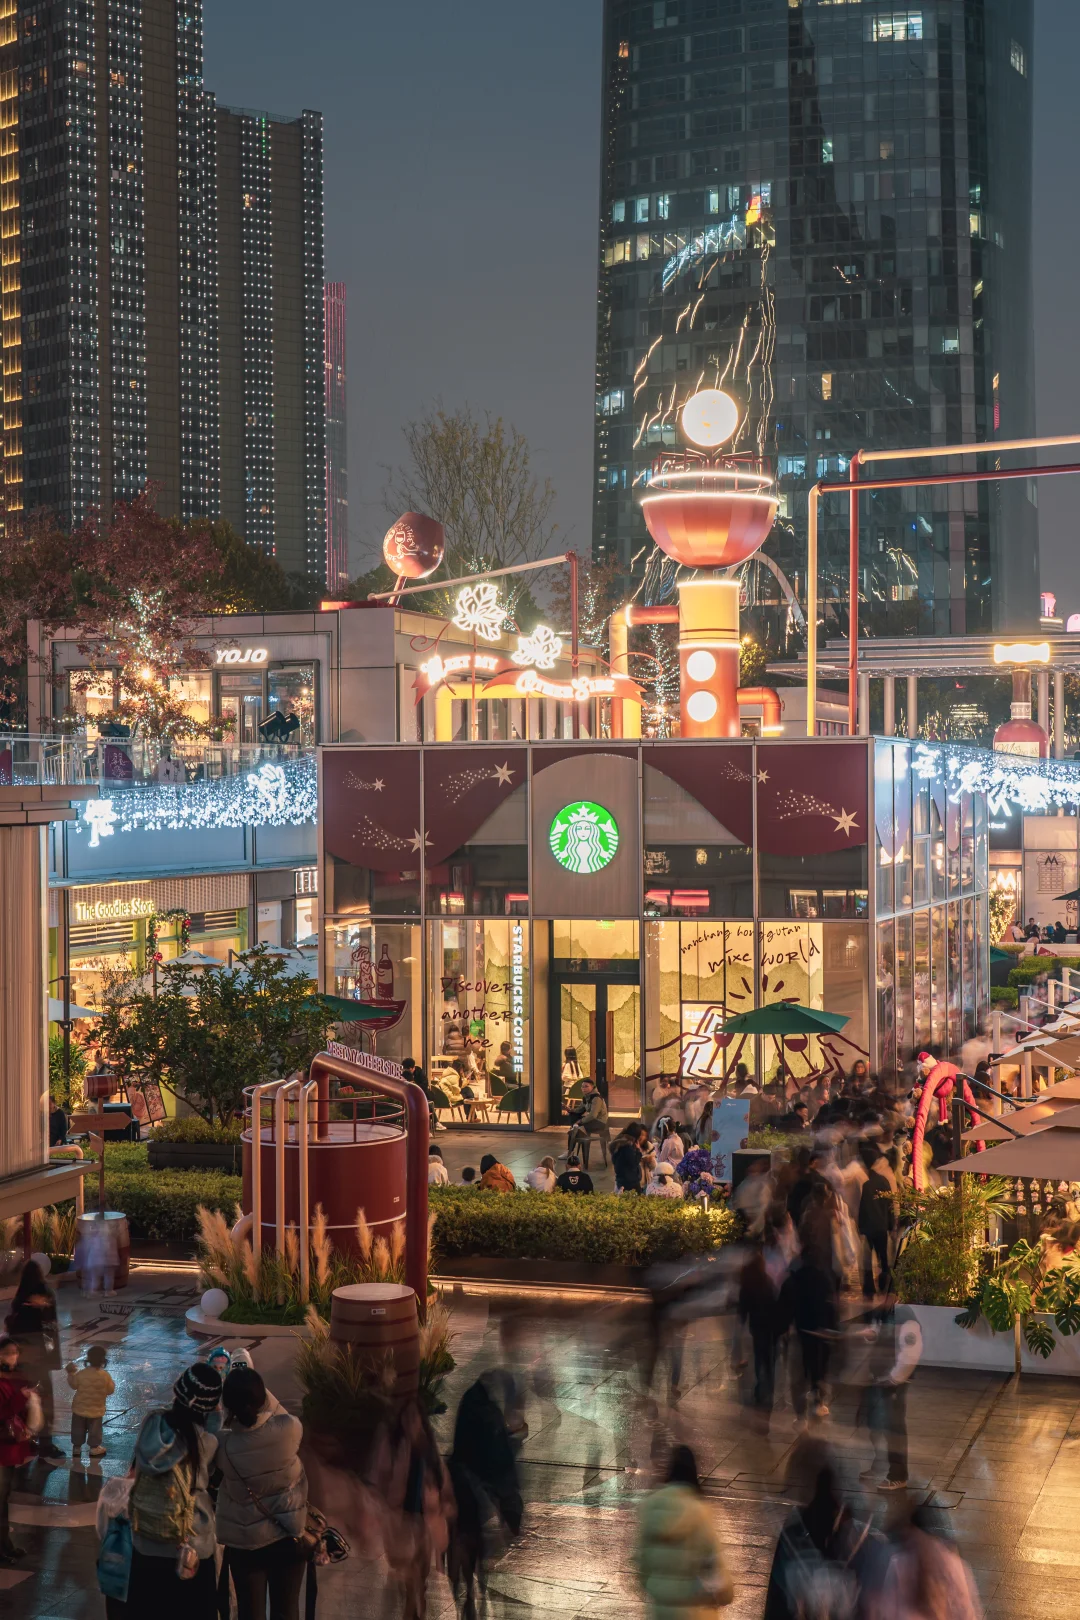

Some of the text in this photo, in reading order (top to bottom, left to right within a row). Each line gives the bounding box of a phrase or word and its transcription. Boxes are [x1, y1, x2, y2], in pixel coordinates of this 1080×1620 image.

[216, 648, 268, 664] YOJO
[77, 898, 155, 920] The Goodies Store
[512, 926, 524, 1073] STARBUCKS COFFEE
[463, 1036, 493, 1048] me
